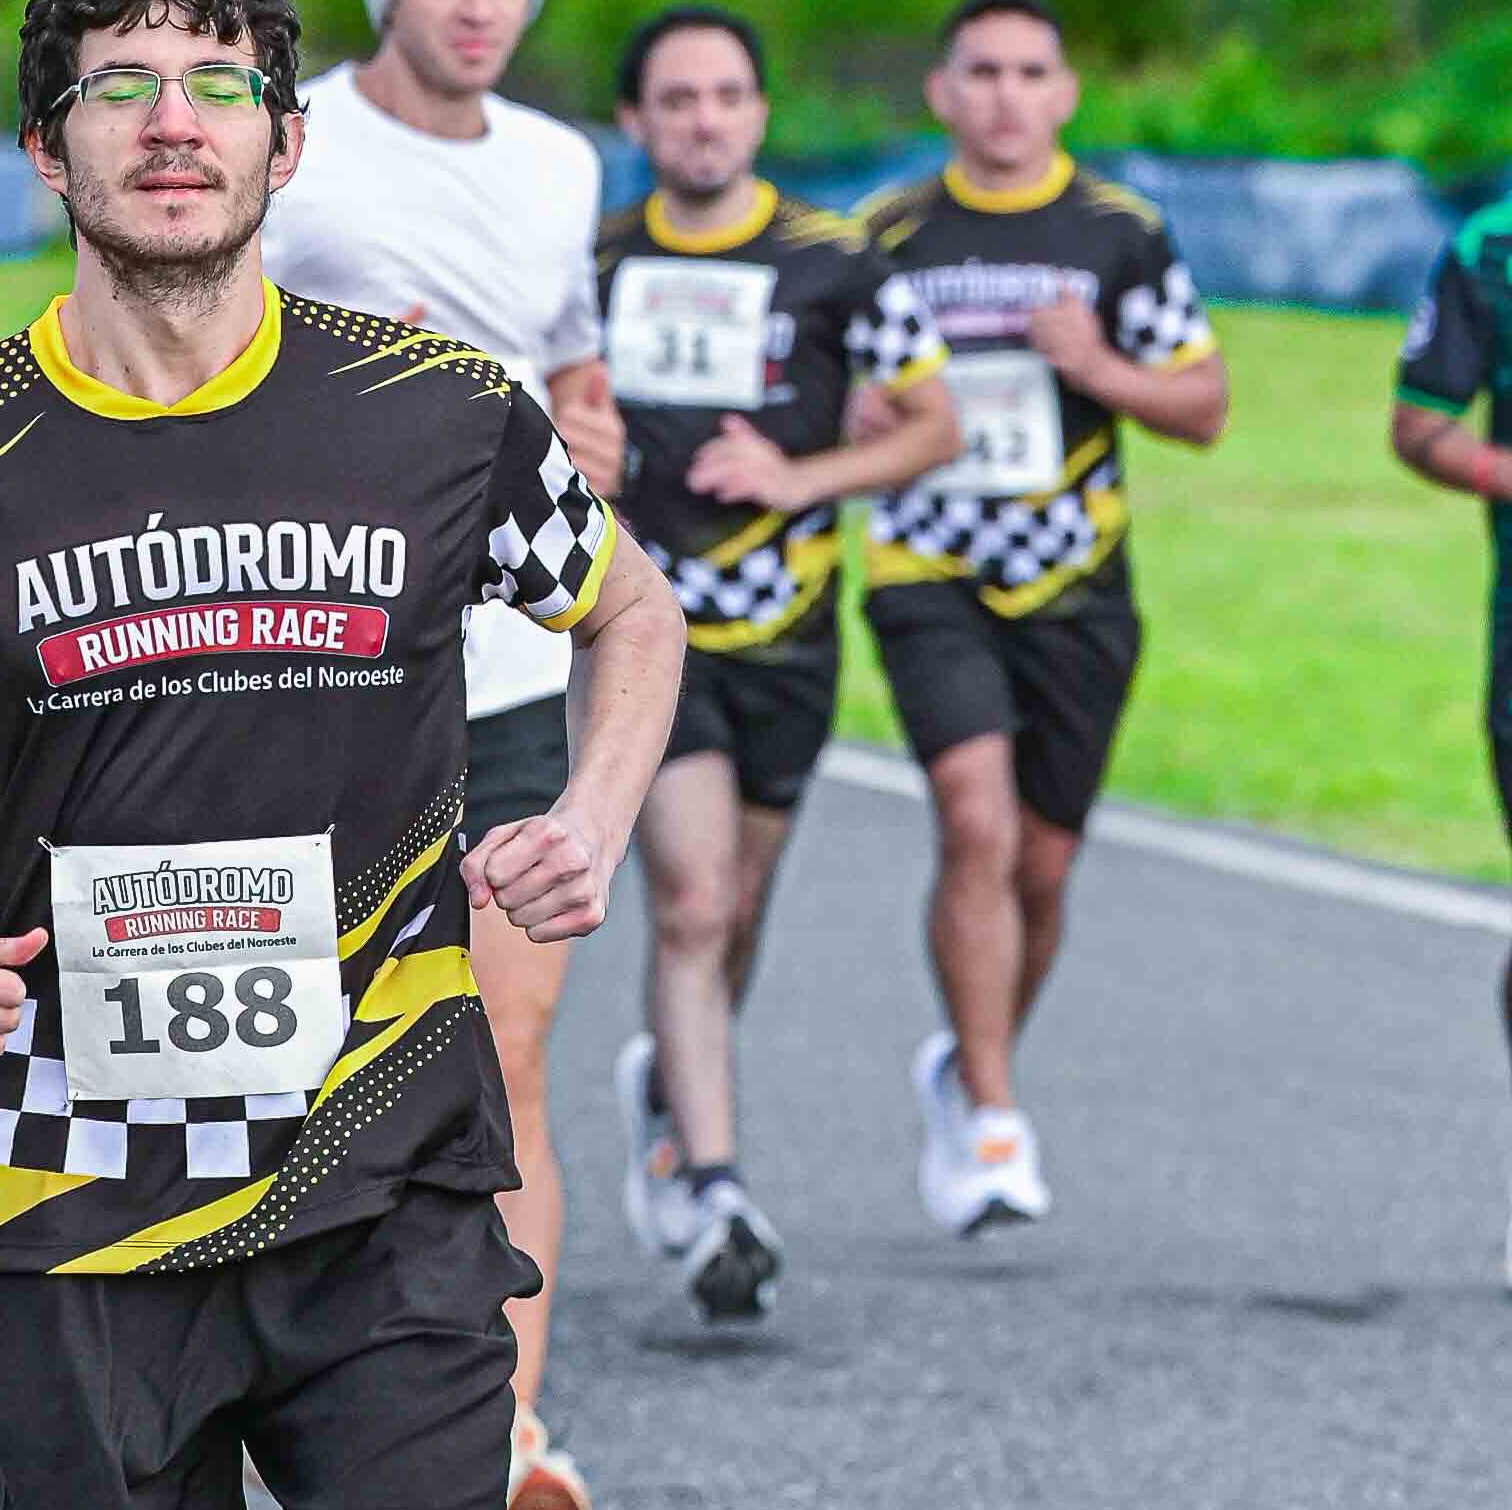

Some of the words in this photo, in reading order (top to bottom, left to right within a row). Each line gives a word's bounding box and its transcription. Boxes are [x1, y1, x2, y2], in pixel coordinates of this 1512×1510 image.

[16, 512, 407, 634] AUTÓDROMO
[76, 608, 240, 674] RUNNING
[250, 607, 349, 650] RACE
[47, 688, 123, 712] Carrera
[129, 681, 156, 702] de
[162, 677, 192, 697] los
[197, 670, 272, 693] Clubes
[278, 667, 312, 689] del
[318, 665, 405, 688] Noroeste
[93, 860, 294, 915] AUTÓDROMO
[91, 946, 105, 958] La
[106, 944, 149, 958] Carrera
[150, 942, 166, 956] de
[167, 941, 185, 955] los
[186, 938, 225, 954] Clubes
[227, 937, 245, 951] del
[247, 935, 297, 949] Noroeste
[124, 909, 206, 939] RUNNING
[212, 907, 262, 930] RACE
[103, 966, 298, 1055] 188
